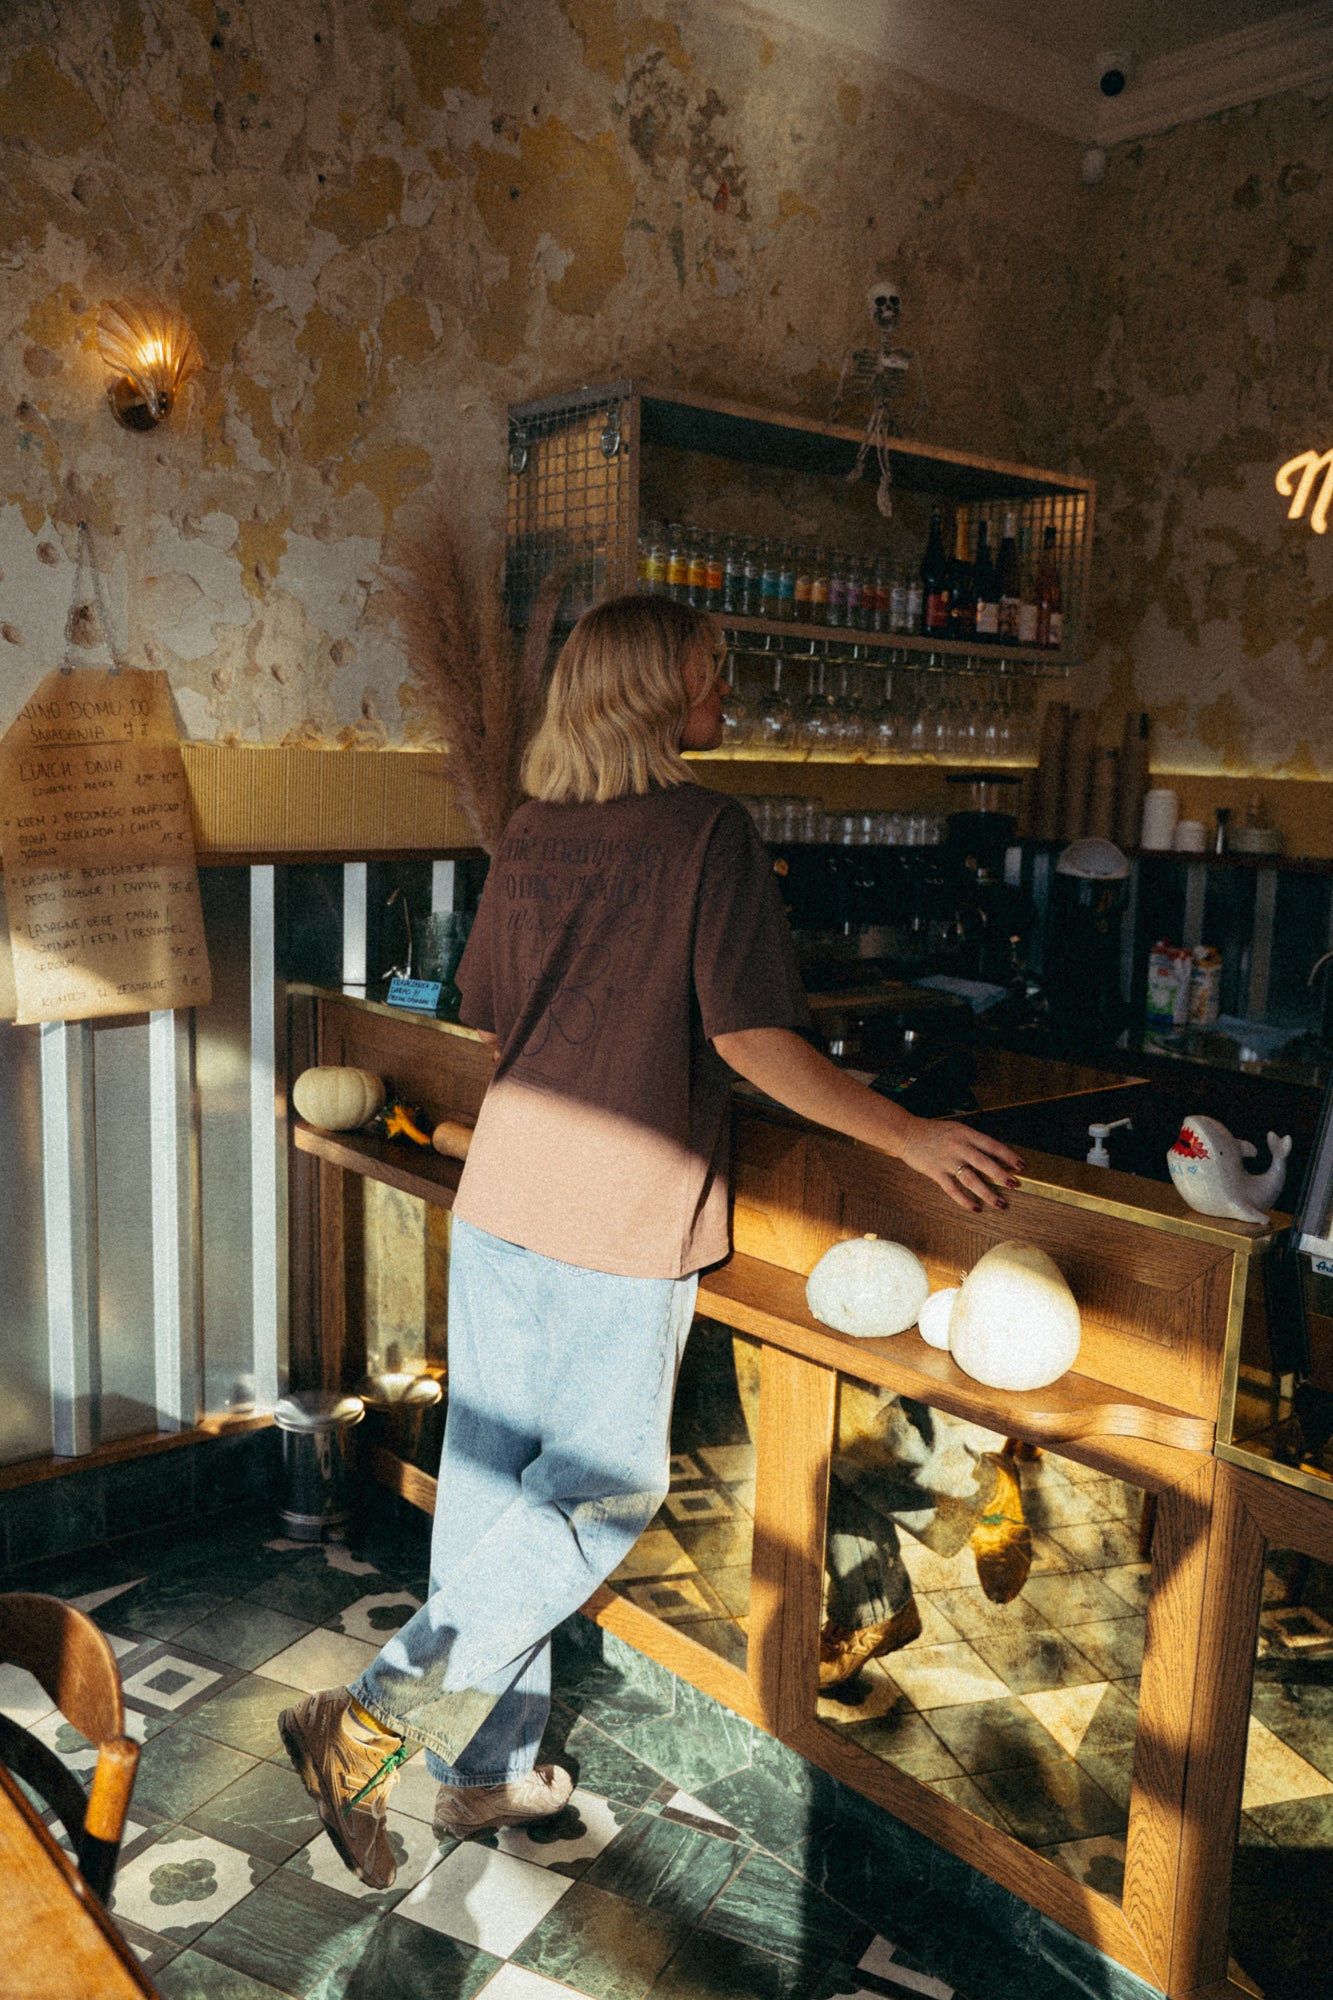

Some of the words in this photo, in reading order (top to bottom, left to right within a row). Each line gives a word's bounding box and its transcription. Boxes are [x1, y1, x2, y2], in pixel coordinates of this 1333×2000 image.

[69, 700, 122, 720] DOMU
[130, 699, 151, 718] DO
[19, 761, 73, 783] LUNCH
[85, 758, 123, 775] DNIA
[17, 814, 46, 828] KREM
[56, 826, 115, 842] CZEKOLADA
[20, 870, 73, 888] LASAGNE
[24, 891, 57, 908] PESTO
[27, 918, 80, 940] LASAGNE
[90, 931, 118, 946] FETA
